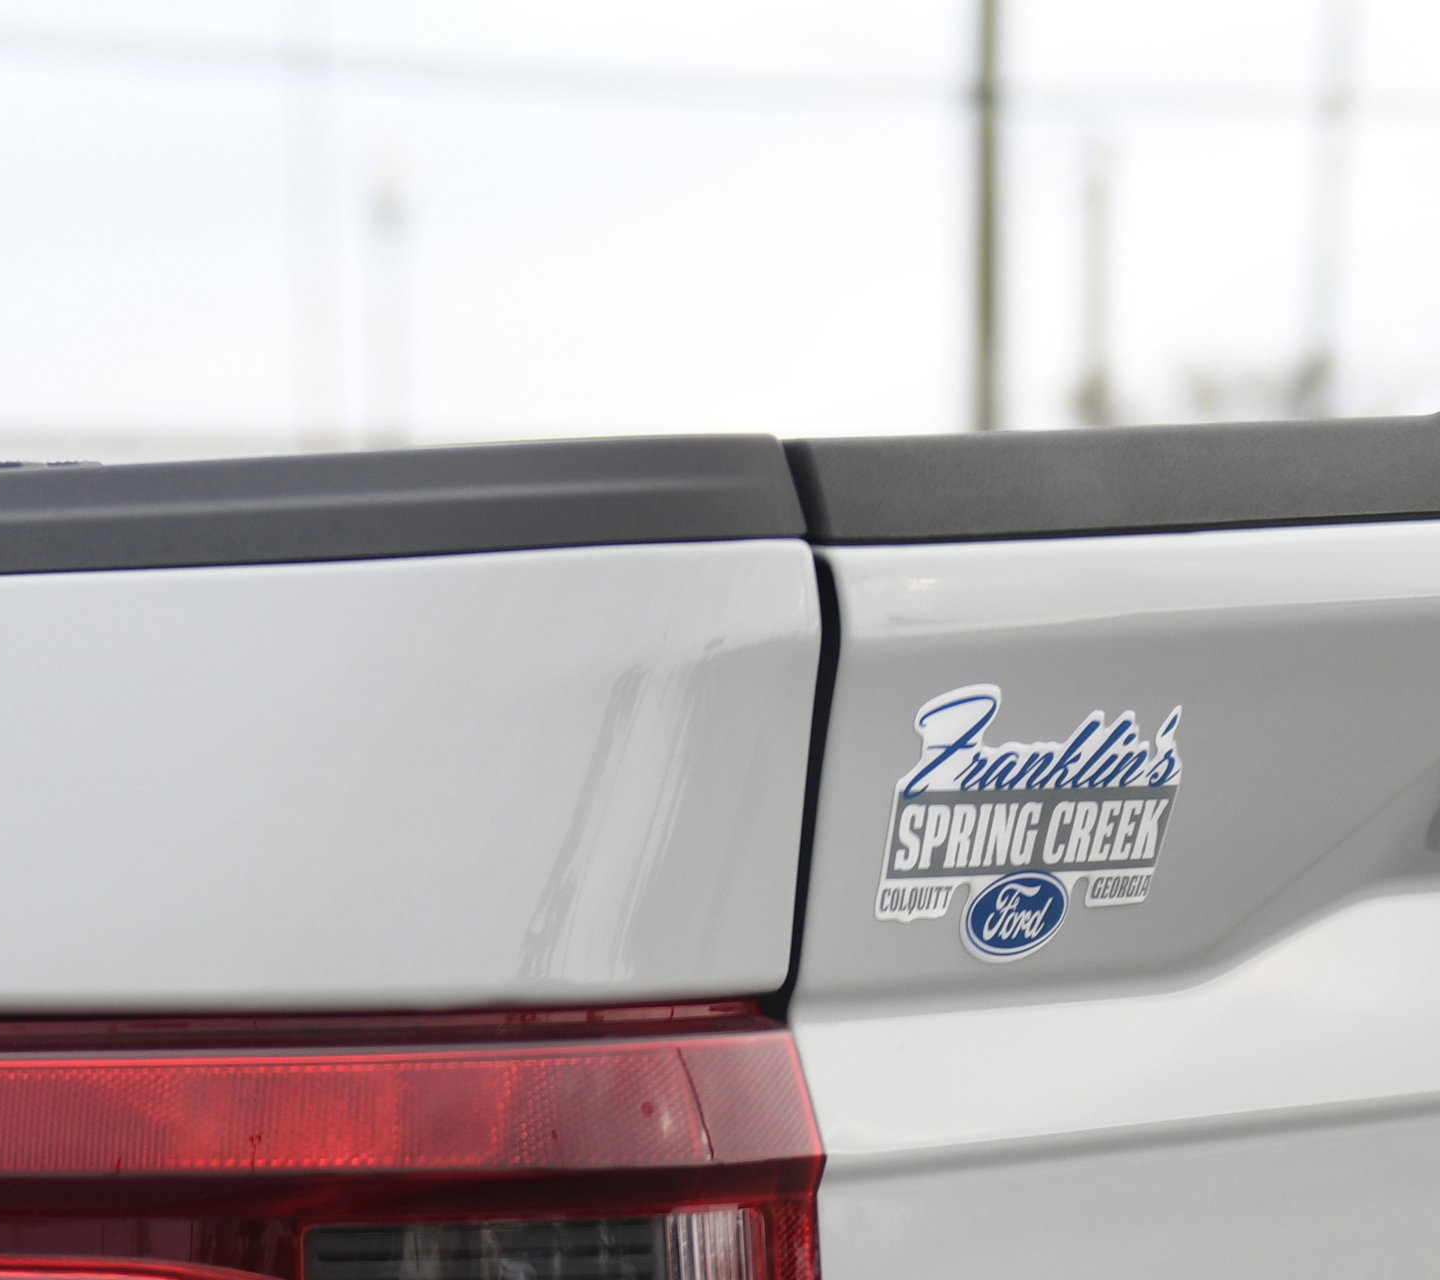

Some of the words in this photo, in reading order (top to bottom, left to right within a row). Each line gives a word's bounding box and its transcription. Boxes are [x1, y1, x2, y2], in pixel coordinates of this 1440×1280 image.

[902, 695, 1181, 799] Franklin's
[893, 801, 1040, 872] SPRING
[1042, 798, 1169, 865] CREEK
[880, 885, 953, 915] COLQUITT
[982, 882, 1054, 942] Ford
[1090, 874, 1152, 900] GEORGIA
